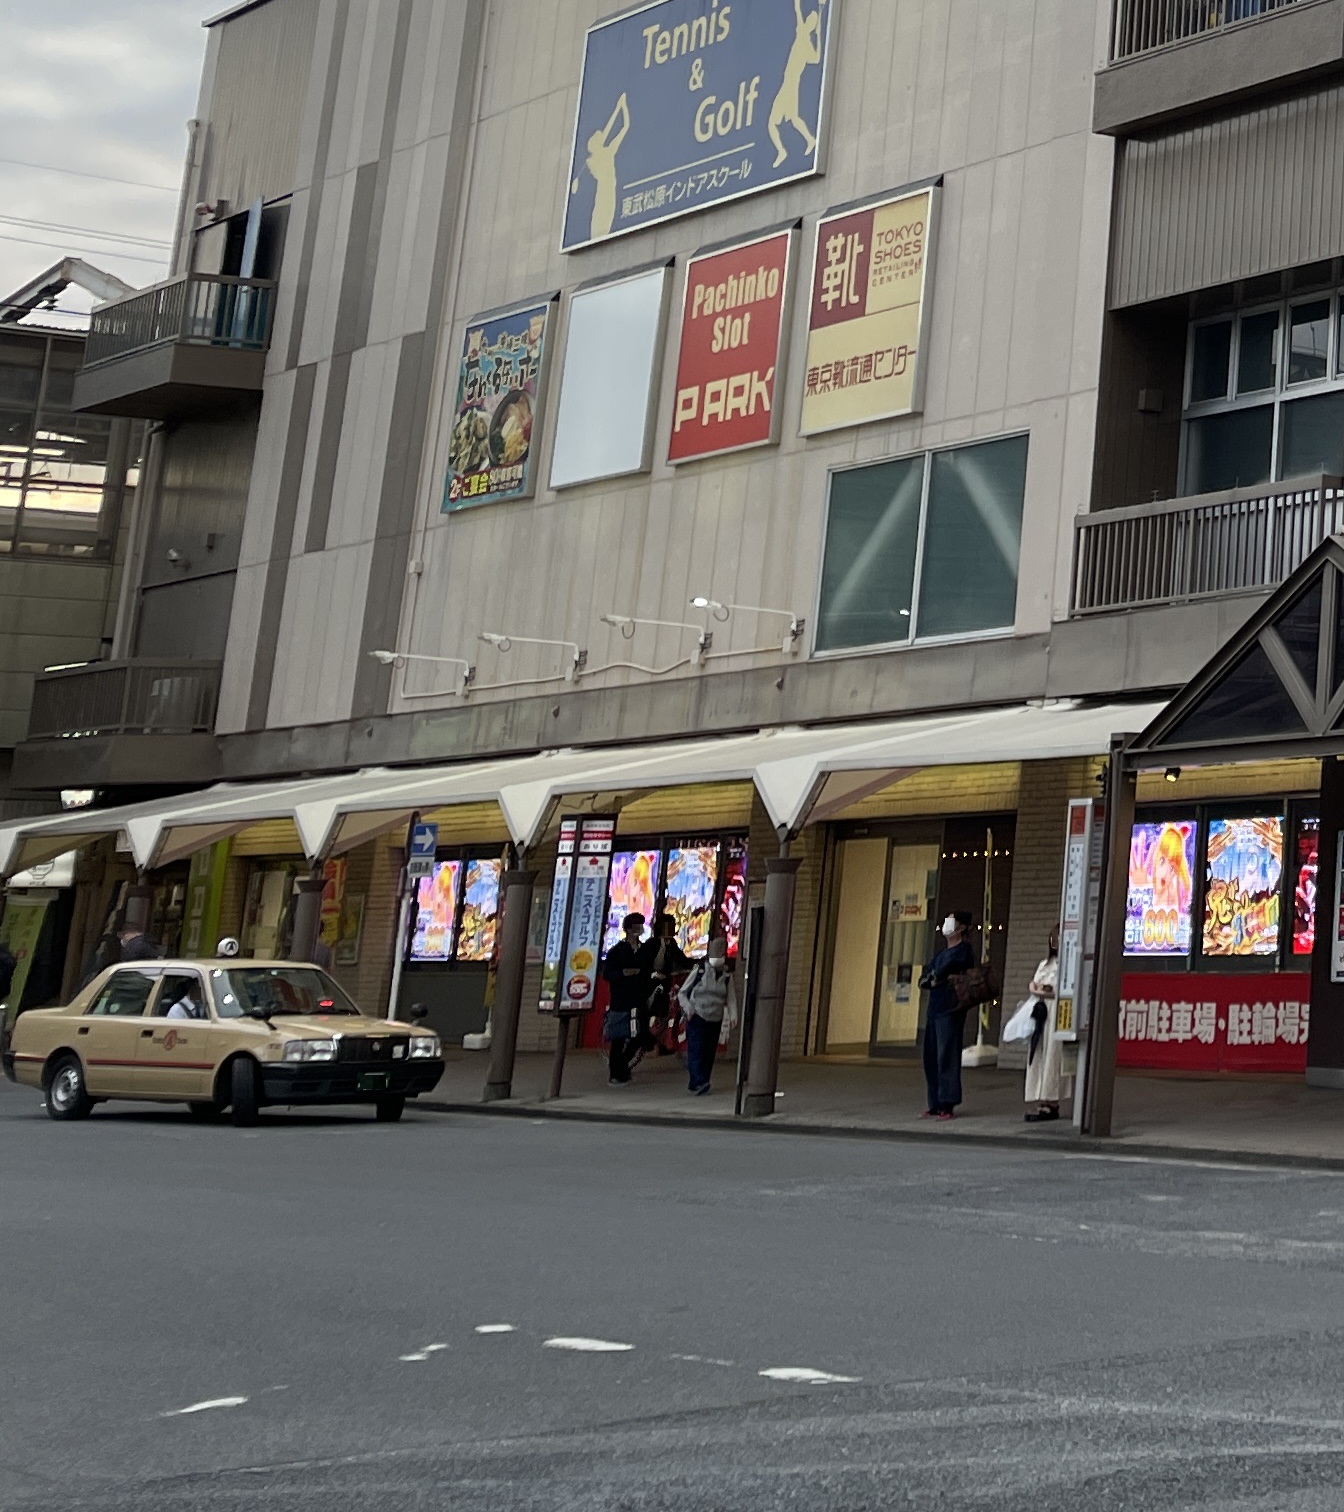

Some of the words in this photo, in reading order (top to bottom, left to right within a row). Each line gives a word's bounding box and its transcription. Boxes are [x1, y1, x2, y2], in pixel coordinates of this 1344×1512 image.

[688, 58, 705, 91] &
[694, 76, 760, 144] Golf
[620, 158, 753, 219] 東武松原インドアスクール
[873, 239, 923, 265] SHOES
[877, 220, 924, 247] TOKYO
[820, 231, 865, 312] 靴
[872, 258, 915, 276] RETAILING
[872, 270, 916, 288] CENTER
[691, 267, 779, 320] Pachinko
[711, 313, 749, 355] Slot
[805, 344, 917, 398] 東京靴流通センター
[673, 366, 773, 433] PARK
